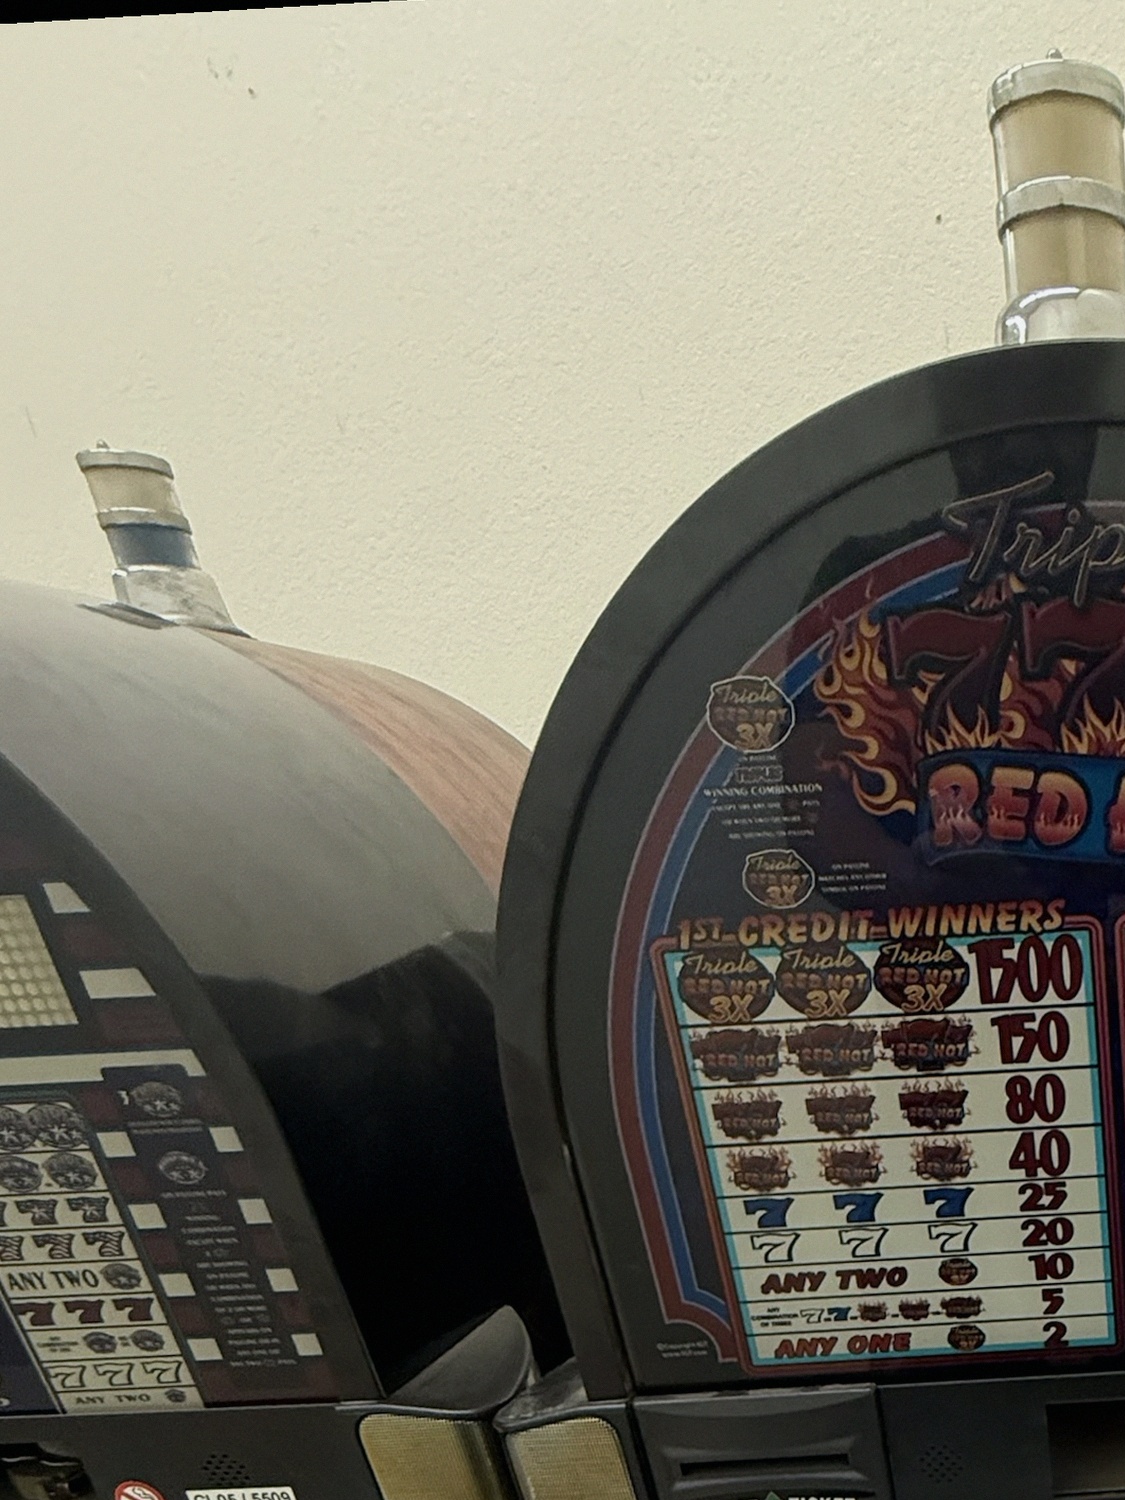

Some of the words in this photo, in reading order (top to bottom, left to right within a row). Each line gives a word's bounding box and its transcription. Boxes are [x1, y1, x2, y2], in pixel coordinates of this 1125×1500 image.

[703, 787, 749, 797] WINNING
[751, 783, 823, 796] COMBINATION
[929, 764, 1089, 850] RED
[678, 916, 724, 949] 1ST
[738, 911, 874, 947] CREDIT
[888, 902, 1065, 938] WINNERS
[968, 933, 1084, 1004] 1500
[990, 1011, 1070, 1064] 150
[1006, 1074, 1066, 1124] 80
[1009, 1129, 1071, 1177] 40
[1019, 1181, 1068, 1211] 25
[1021, 1217, 1074, 1246] 20
[8, 1270, 47, 1291] ANY
[51, 1269, 99, 1289] TWO
[761, 1271, 826, 1294] ANY
[836, 1266, 908, 1291] TWO
[1028, 1252, 1074, 1281] 10
[1042, 1289, 1064, 1315] 5
[774, 1337, 838, 1358] ANY
[847, 1332, 912, 1355] ONE
[1042, 1321, 1068, 1348] 2
[75, 1395, 106, 1404] ANY
[117, 1394, 151, 1403] TWO
